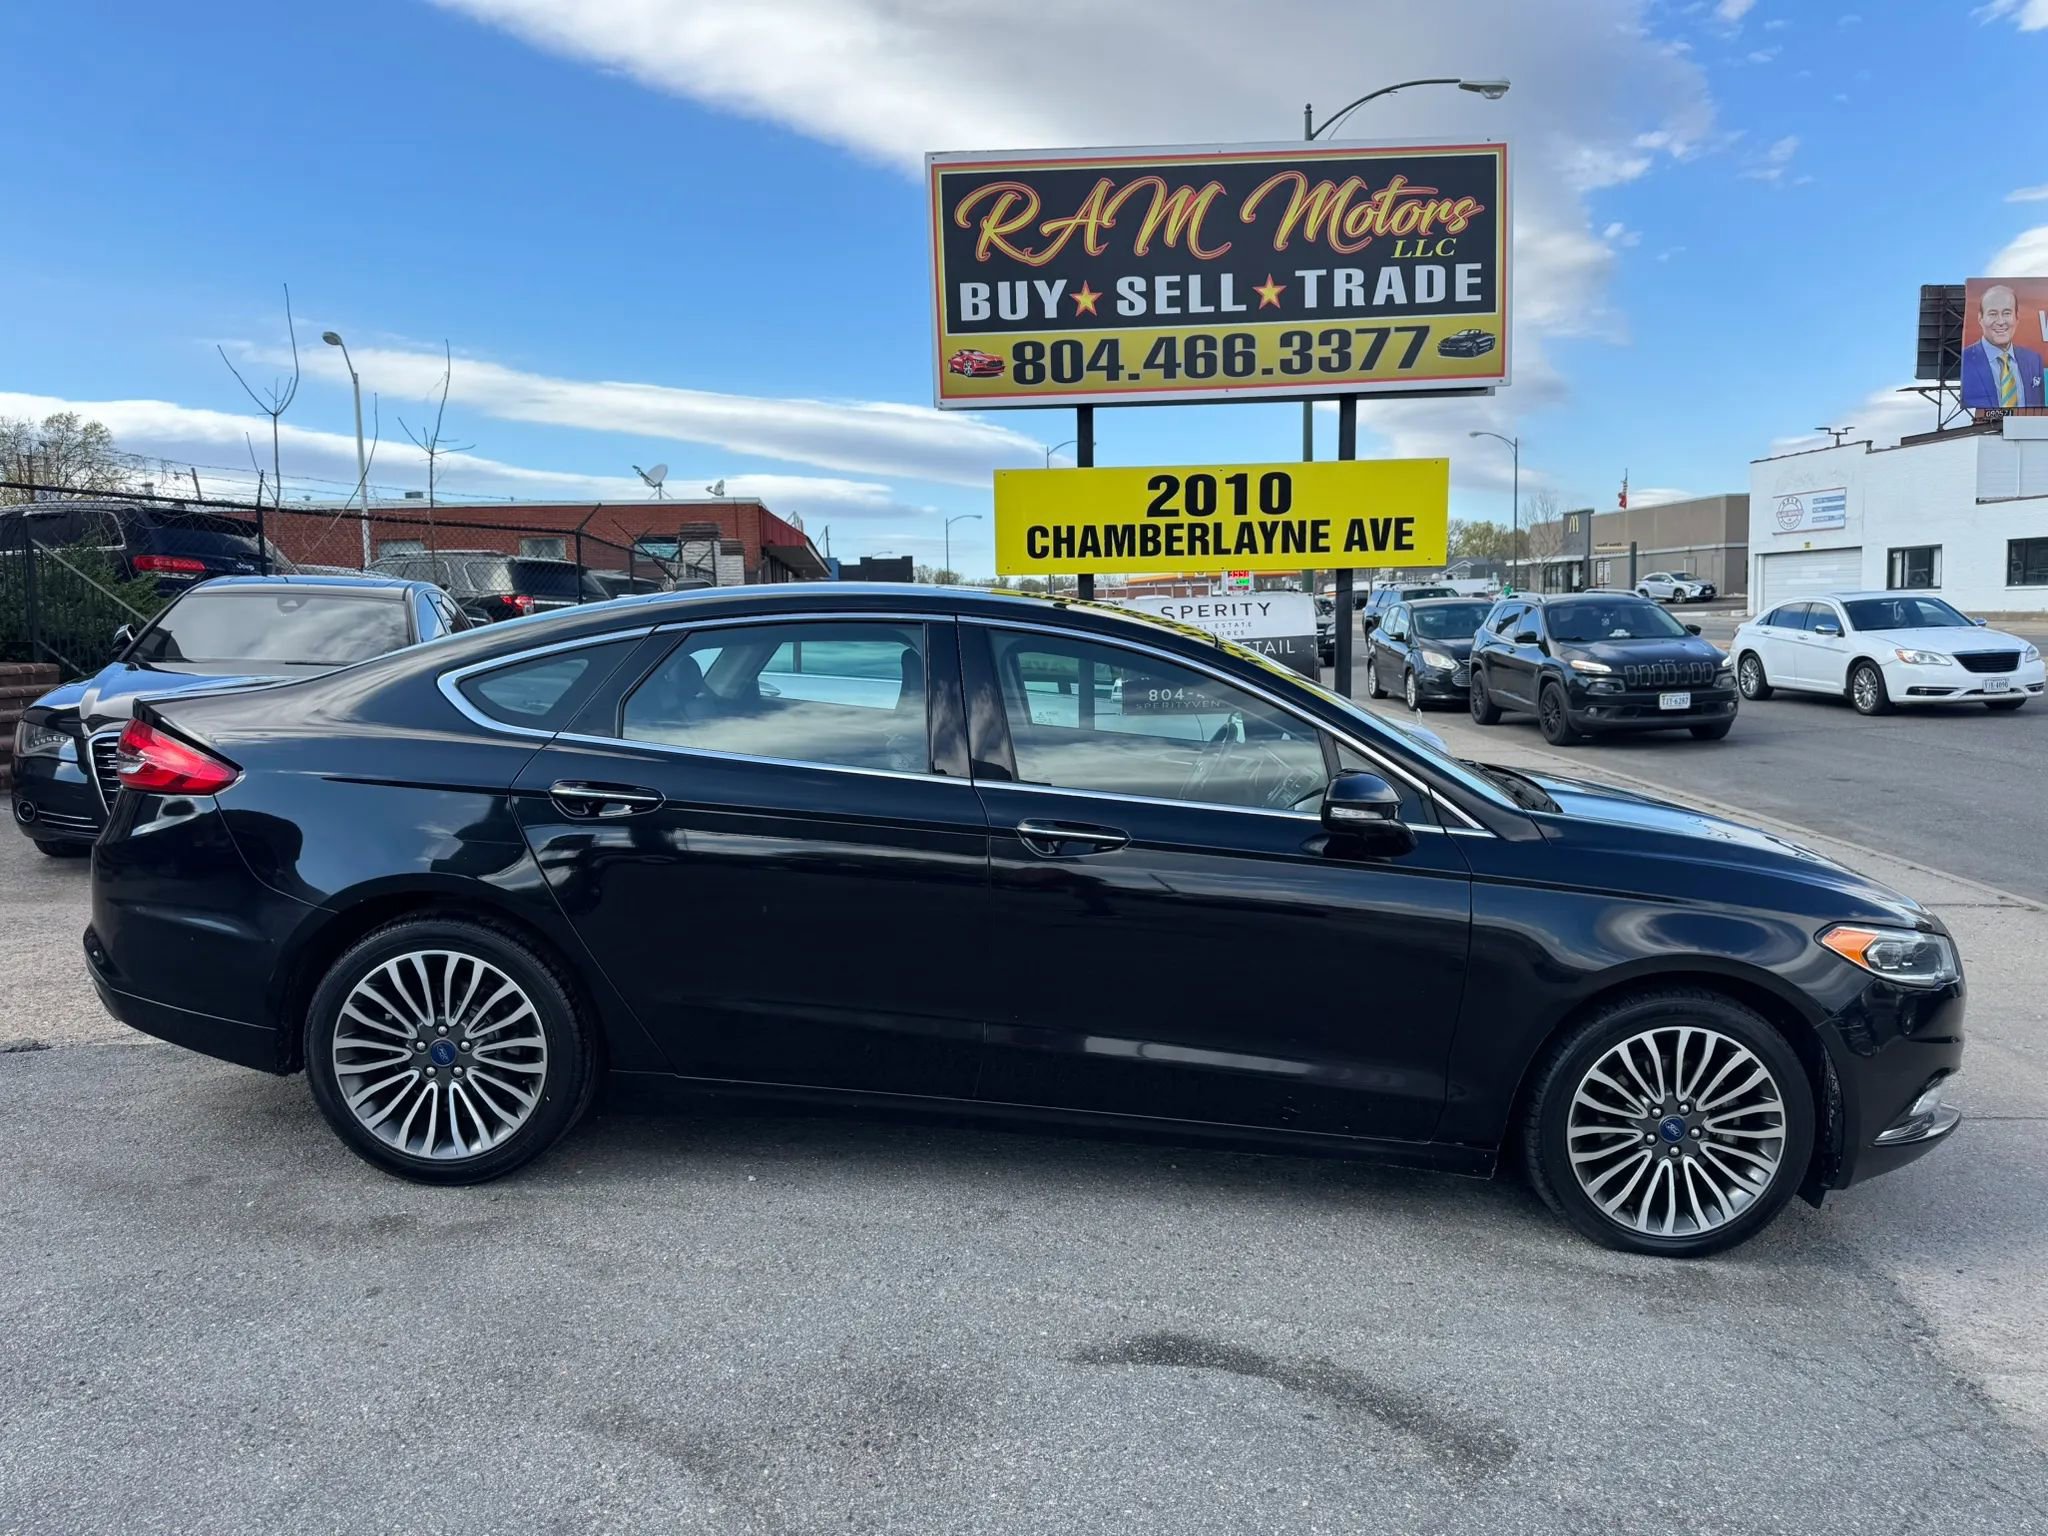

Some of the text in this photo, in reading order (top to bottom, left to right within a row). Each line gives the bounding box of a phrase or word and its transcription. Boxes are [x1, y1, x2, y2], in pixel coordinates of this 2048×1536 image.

[954, 171, 1485, 266] RAM Motors
[1391, 238, 1457, 259] LLC
[959, 263, 1482, 321] BUY SELL TRADE
[1012, 325, 1430, 385] 804.466.3377
[1146, 471, 1292, 518] 2010
[1026, 517, 1415, 559] CHAMBERLAYNE AVE
[1214, 622, 1253, 630] ESTATE
